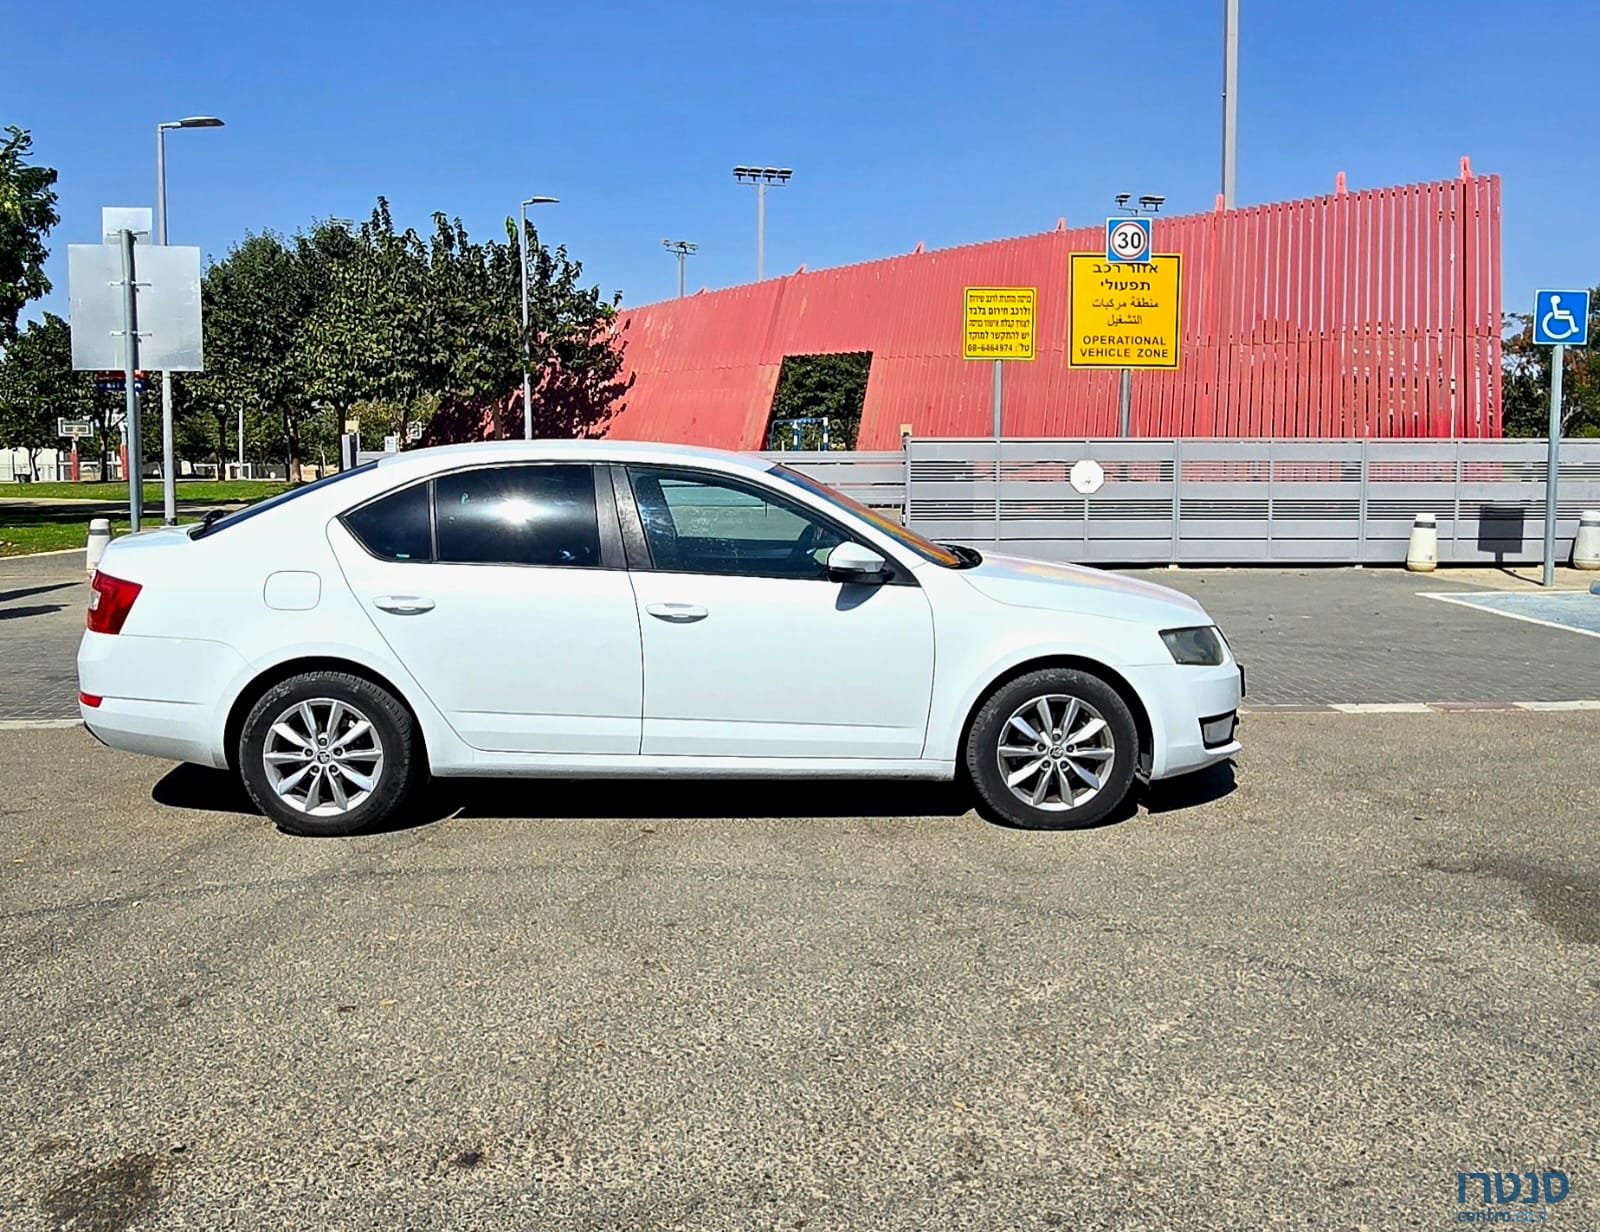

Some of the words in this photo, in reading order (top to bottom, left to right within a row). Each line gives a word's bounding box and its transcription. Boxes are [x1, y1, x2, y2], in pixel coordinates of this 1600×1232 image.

[1118, 232, 1141, 249] 30
[1092, 263, 1120, 273] רכב
[1127, 263, 1158, 273] אזור
[1100, 278, 1150, 291] תפעולי
[1092, 298, 1127, 310] مركبات
[1130, 296, 1159, 307] منطقة
[968, 306, 986, 315] בלבד
[988, 307, 1009, 315] חירום
[1107, 314, 1142, 327] التشغيل
[968, 330, 989, 341] למוקד
[991, 331, 1019, 341] להתקשר
[1021, 331, 1030, 340] יש
[1082, 336, 1166, 345] OPERATIONAL
[1080, 348, 1131, 357] VEHICLE
[1137, 349, 1168, 358] ZONE
